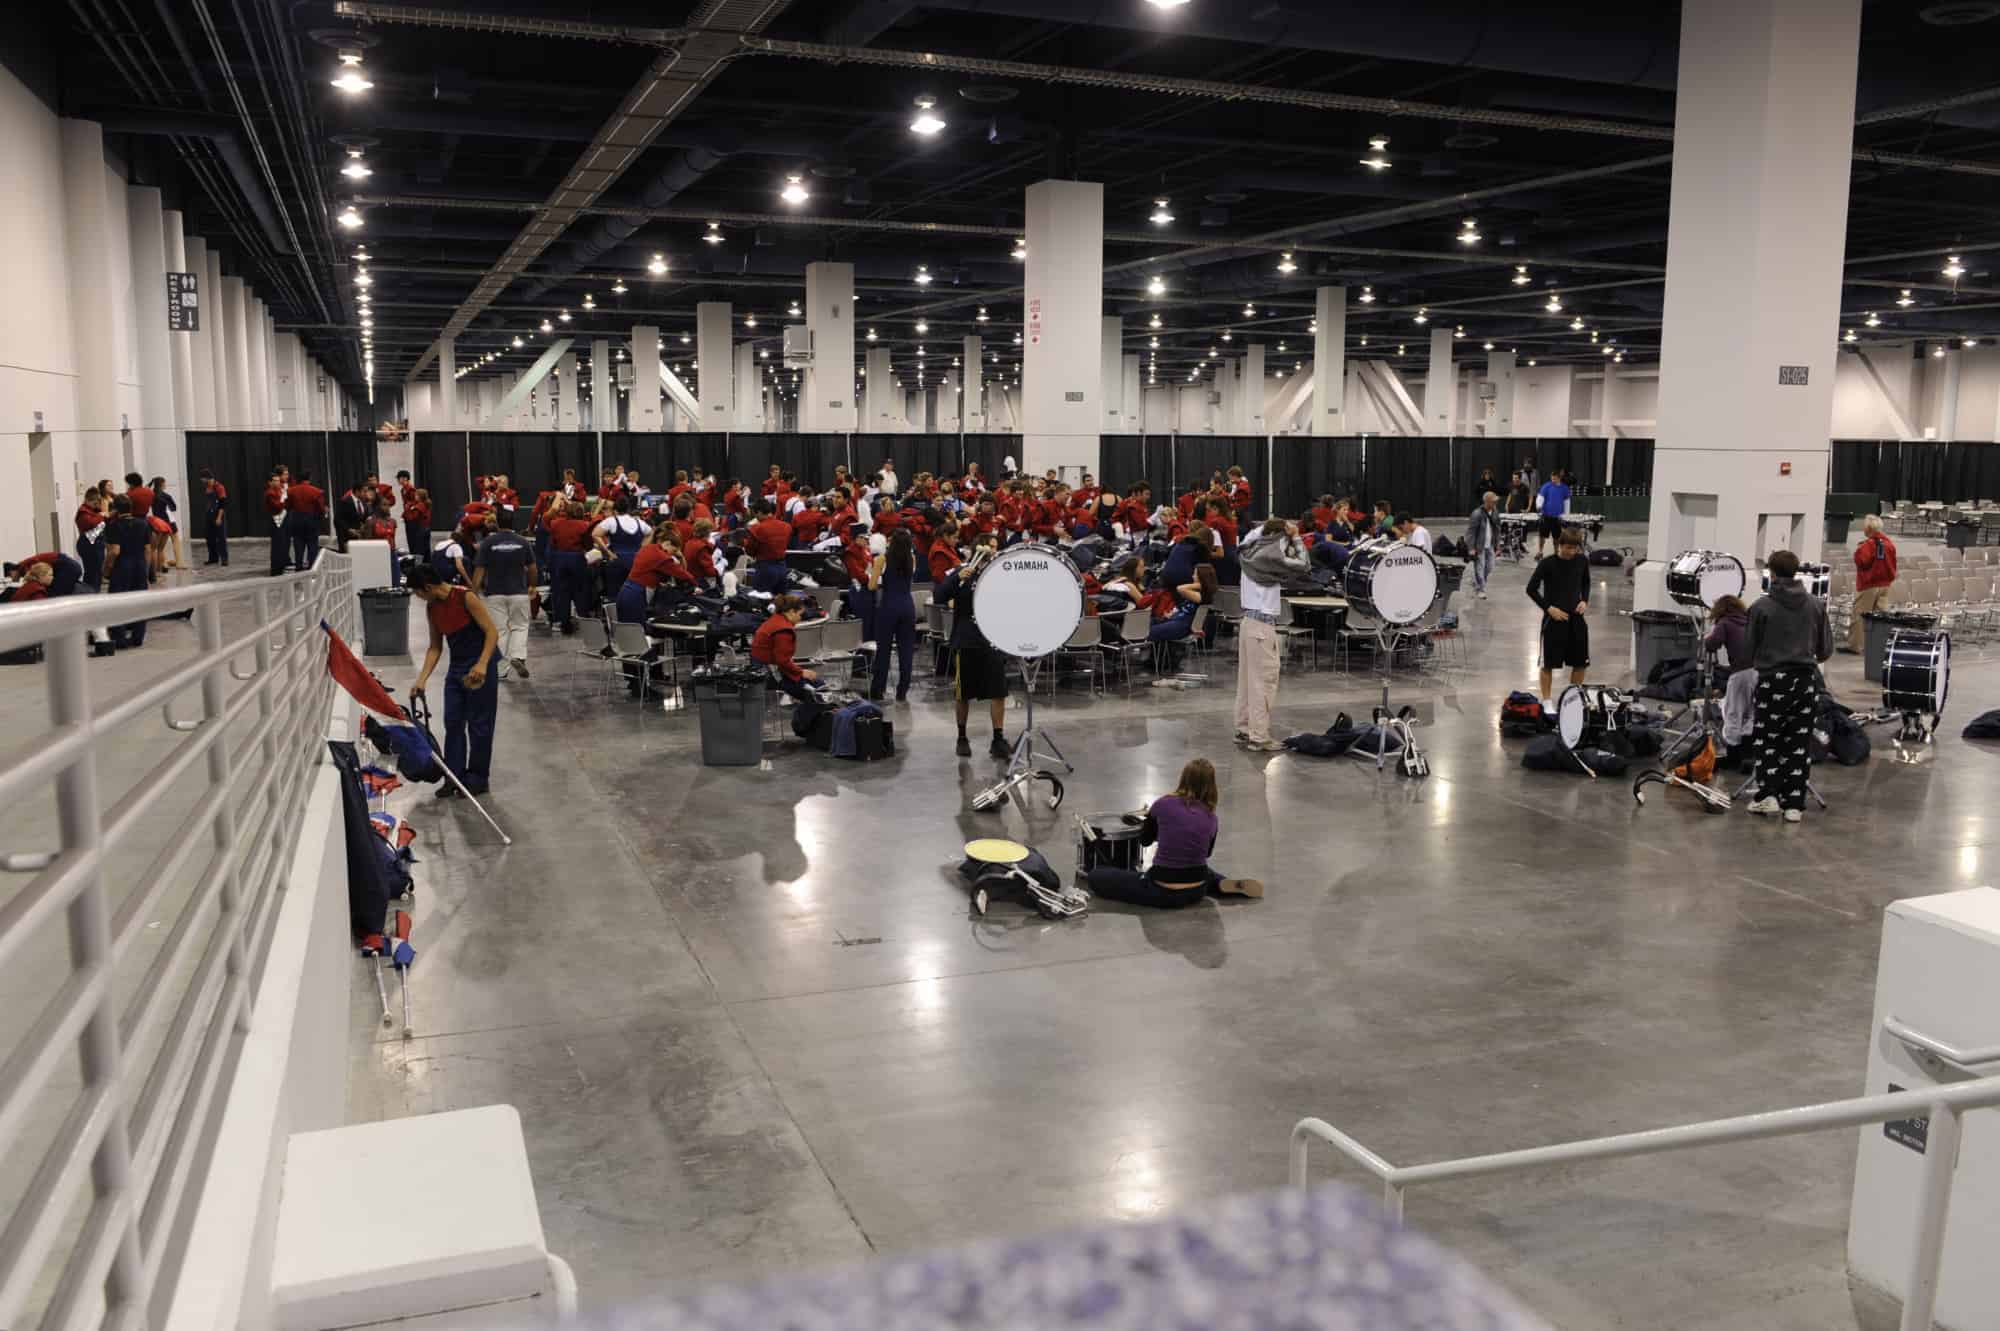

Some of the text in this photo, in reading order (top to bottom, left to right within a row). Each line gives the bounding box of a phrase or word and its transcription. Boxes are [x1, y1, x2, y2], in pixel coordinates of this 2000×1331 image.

[169, 274, 181, 329] RESTROOMS
[1013, 560, 1049, 571] YAMAHA
[1394, 556, 1423, 567] YAMAHA
